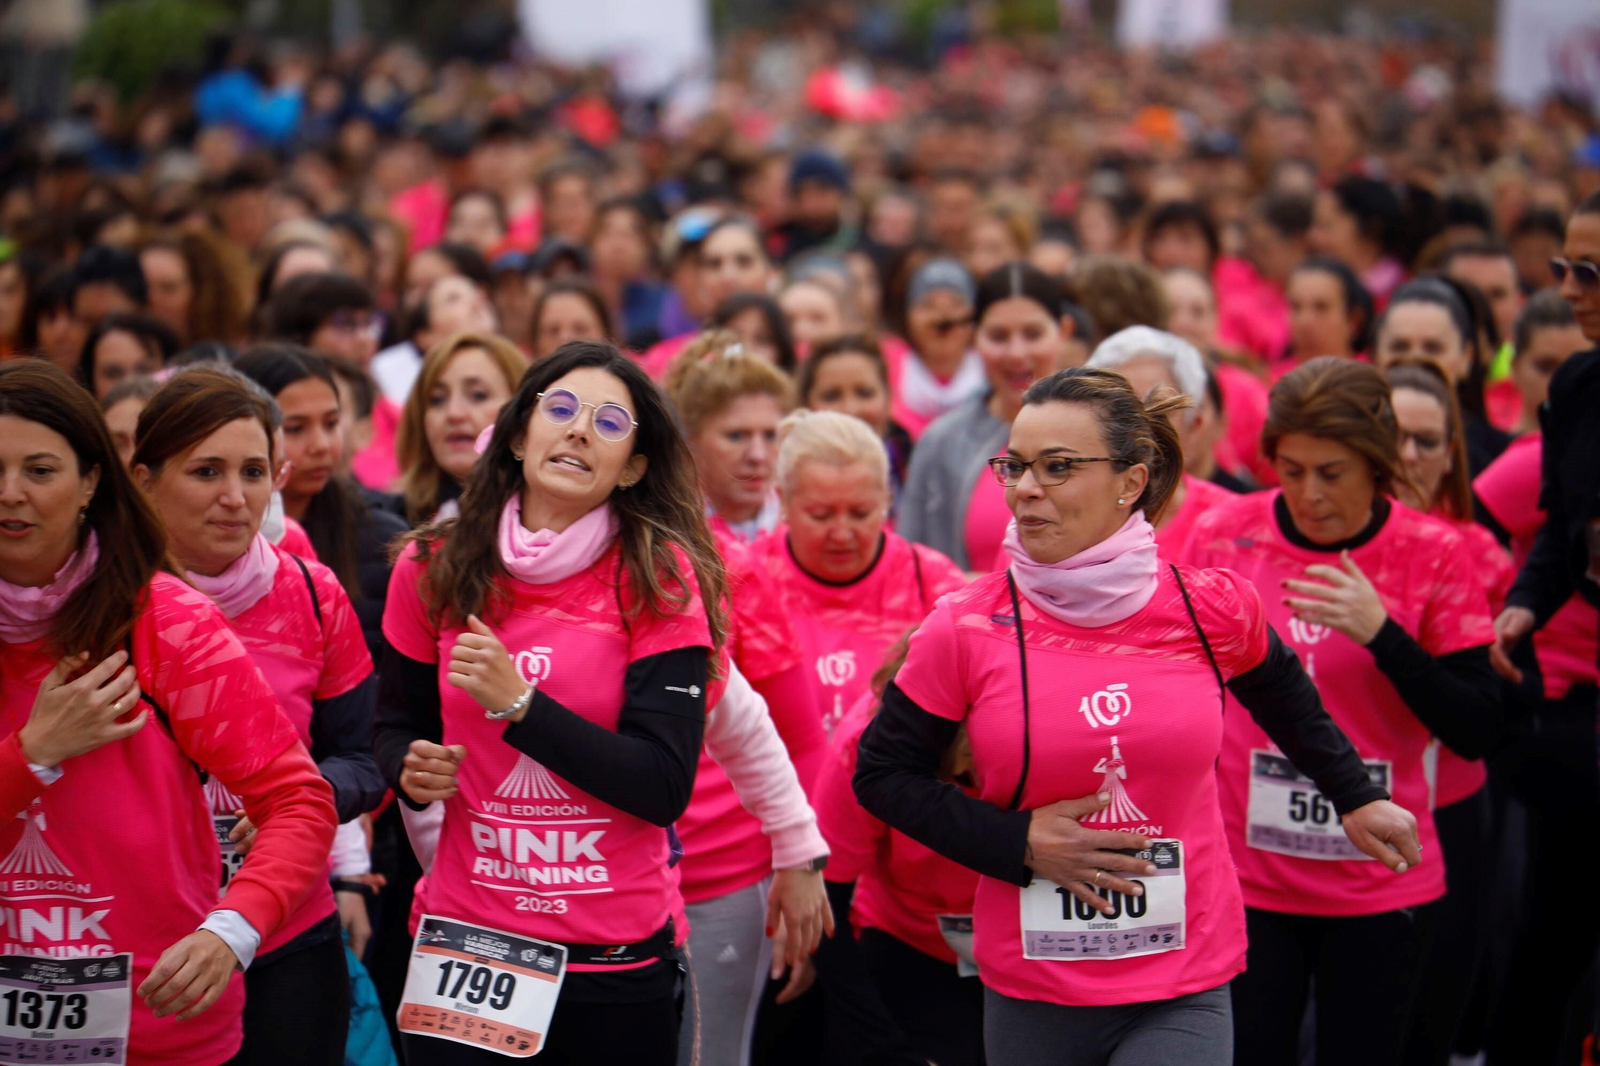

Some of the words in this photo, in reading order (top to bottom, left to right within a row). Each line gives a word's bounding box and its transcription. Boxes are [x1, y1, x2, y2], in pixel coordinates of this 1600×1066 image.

[482, 801, 507, 814] VIII
[511, 804, 588, 816] EDICIÓN
[1289, 790, 1342, 826] 56
[470, 821, 607, 864] PINK
[12, 879, 92, 894] EDICIÓN
[472, 856, 609, 886] RUNNING
[515, 896, 568, 914] 2023
[0, 906, 112, 943] INK
[1088, 922, 1118, 930] Lourdes
[436, 960, 516, 1011] 1799
[3, 990, 88, 1030] 1373
